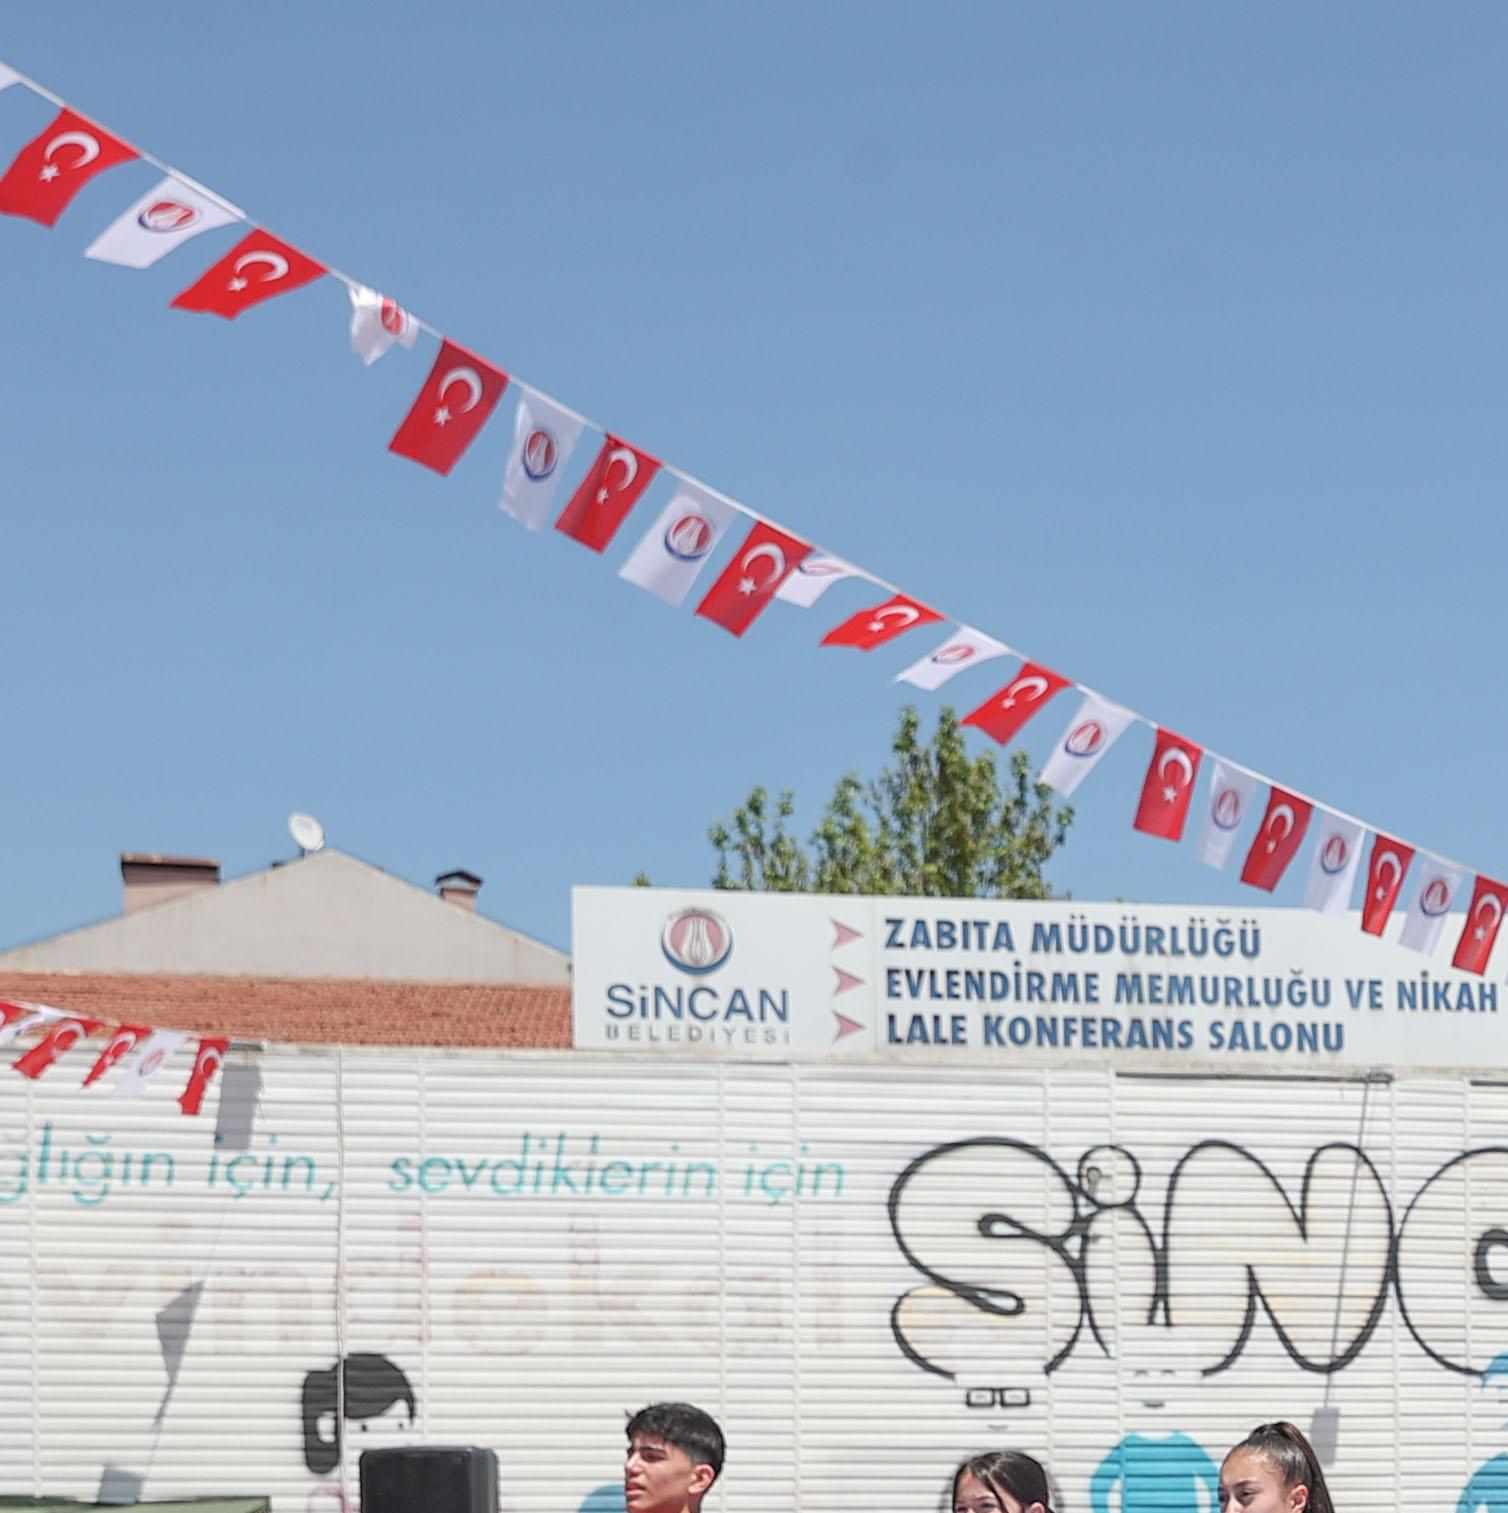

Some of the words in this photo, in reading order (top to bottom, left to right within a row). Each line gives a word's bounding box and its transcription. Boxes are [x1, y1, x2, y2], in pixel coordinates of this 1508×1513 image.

[885, 918, 1015, 952] ZABITA
[1031, 913, 1262, 959] MÜDÜRLÜĞÜ
[886, 960, 1100, 1003] EVLENDİRME
[1115, 968, 1331, 1009] MEMURLUĞU
[1345, 978, 1384, 1010] VE
[1397, 970, 1498, 1013] NİKAH
[888, 1013, 967, 1046] LALE
[983, 1014, 1194, 1050] KONFERANS
[1208, 1019, 1345, 1053] SALONU
[207, 1132, 337, 1201] için,
[387, 1131, 719, 1197] sevdiklerin
[742, 1142, 847, 1206] için
